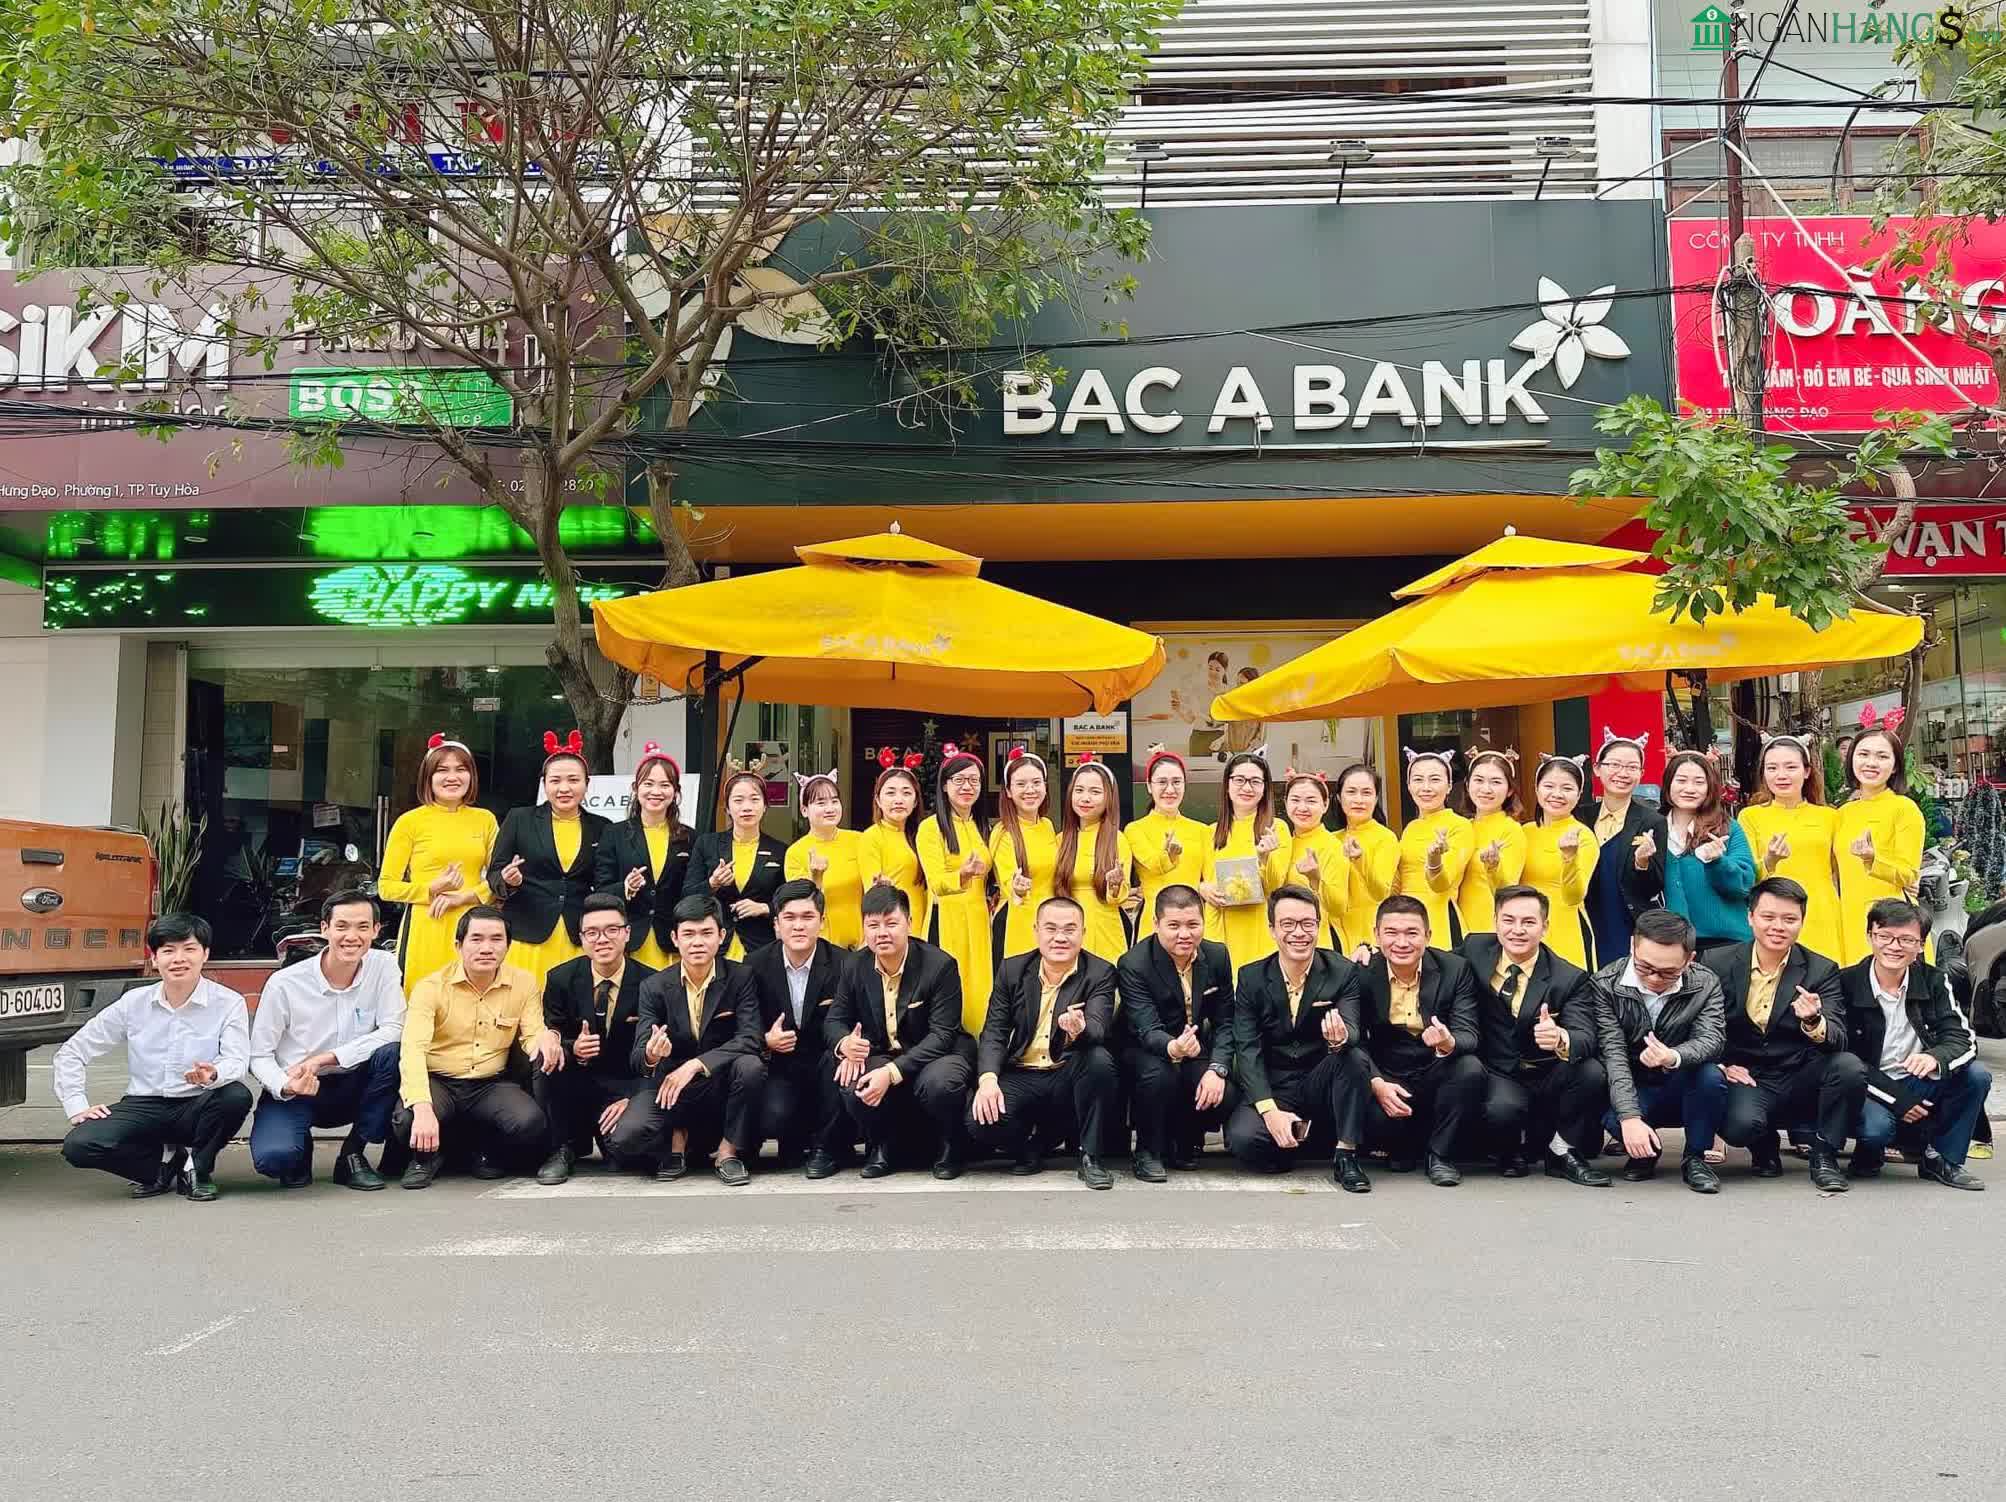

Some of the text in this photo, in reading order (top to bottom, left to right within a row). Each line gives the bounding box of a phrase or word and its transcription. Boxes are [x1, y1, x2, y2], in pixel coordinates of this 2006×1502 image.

[1760, 231, 1786, 248] TY
[1792, 231, 1845, 248] TNHH
[1827, 367, 1851, 388] EM
[1003, 359, 1552, 435] BAC A BANK
[32, 484, 60, 499] Đạo,
[64, 483, 112, 499] Phường
[149, 484, 171, 499] Tuy
[175, 484, 200, 497] Hòa
